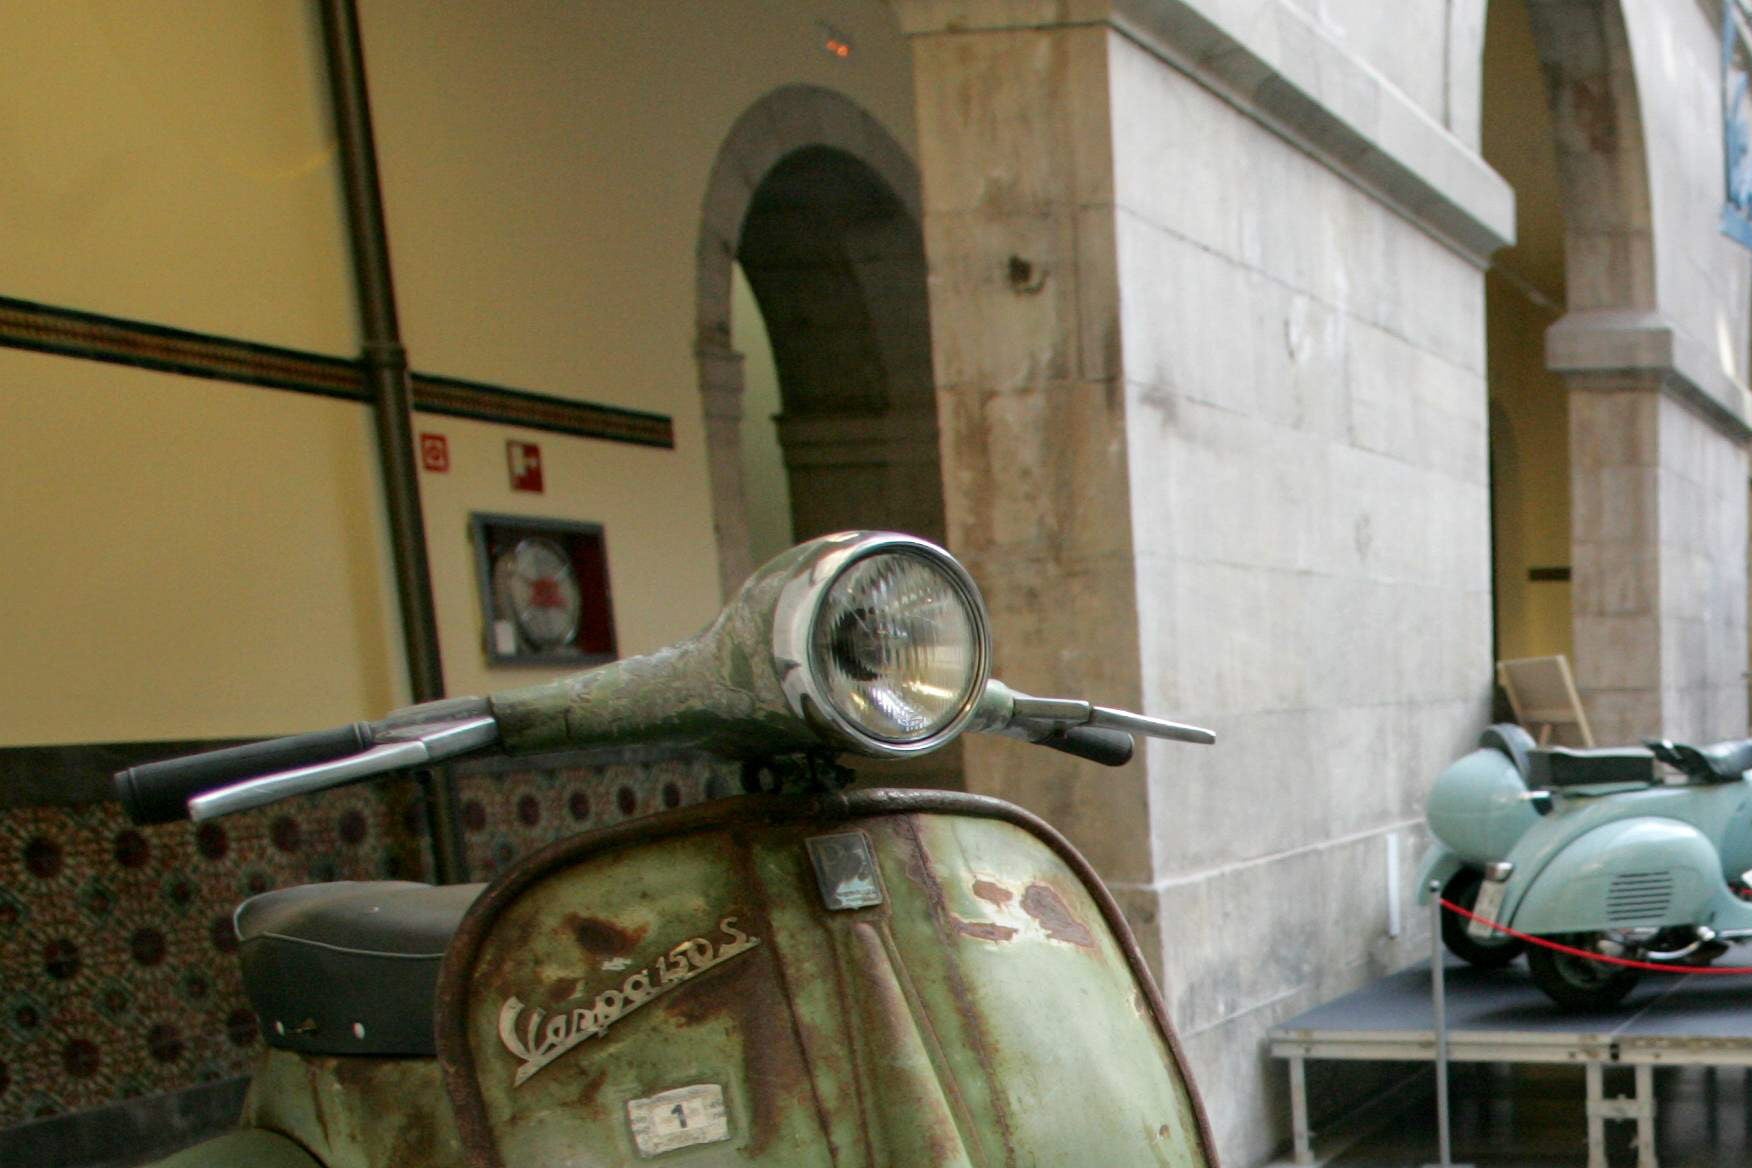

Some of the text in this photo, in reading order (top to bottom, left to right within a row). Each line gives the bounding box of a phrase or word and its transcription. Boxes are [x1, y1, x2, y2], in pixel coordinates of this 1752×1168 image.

[498, 916, 748, 1072] Vespa 150 S
[670, 1104, 688, 1129] 1
